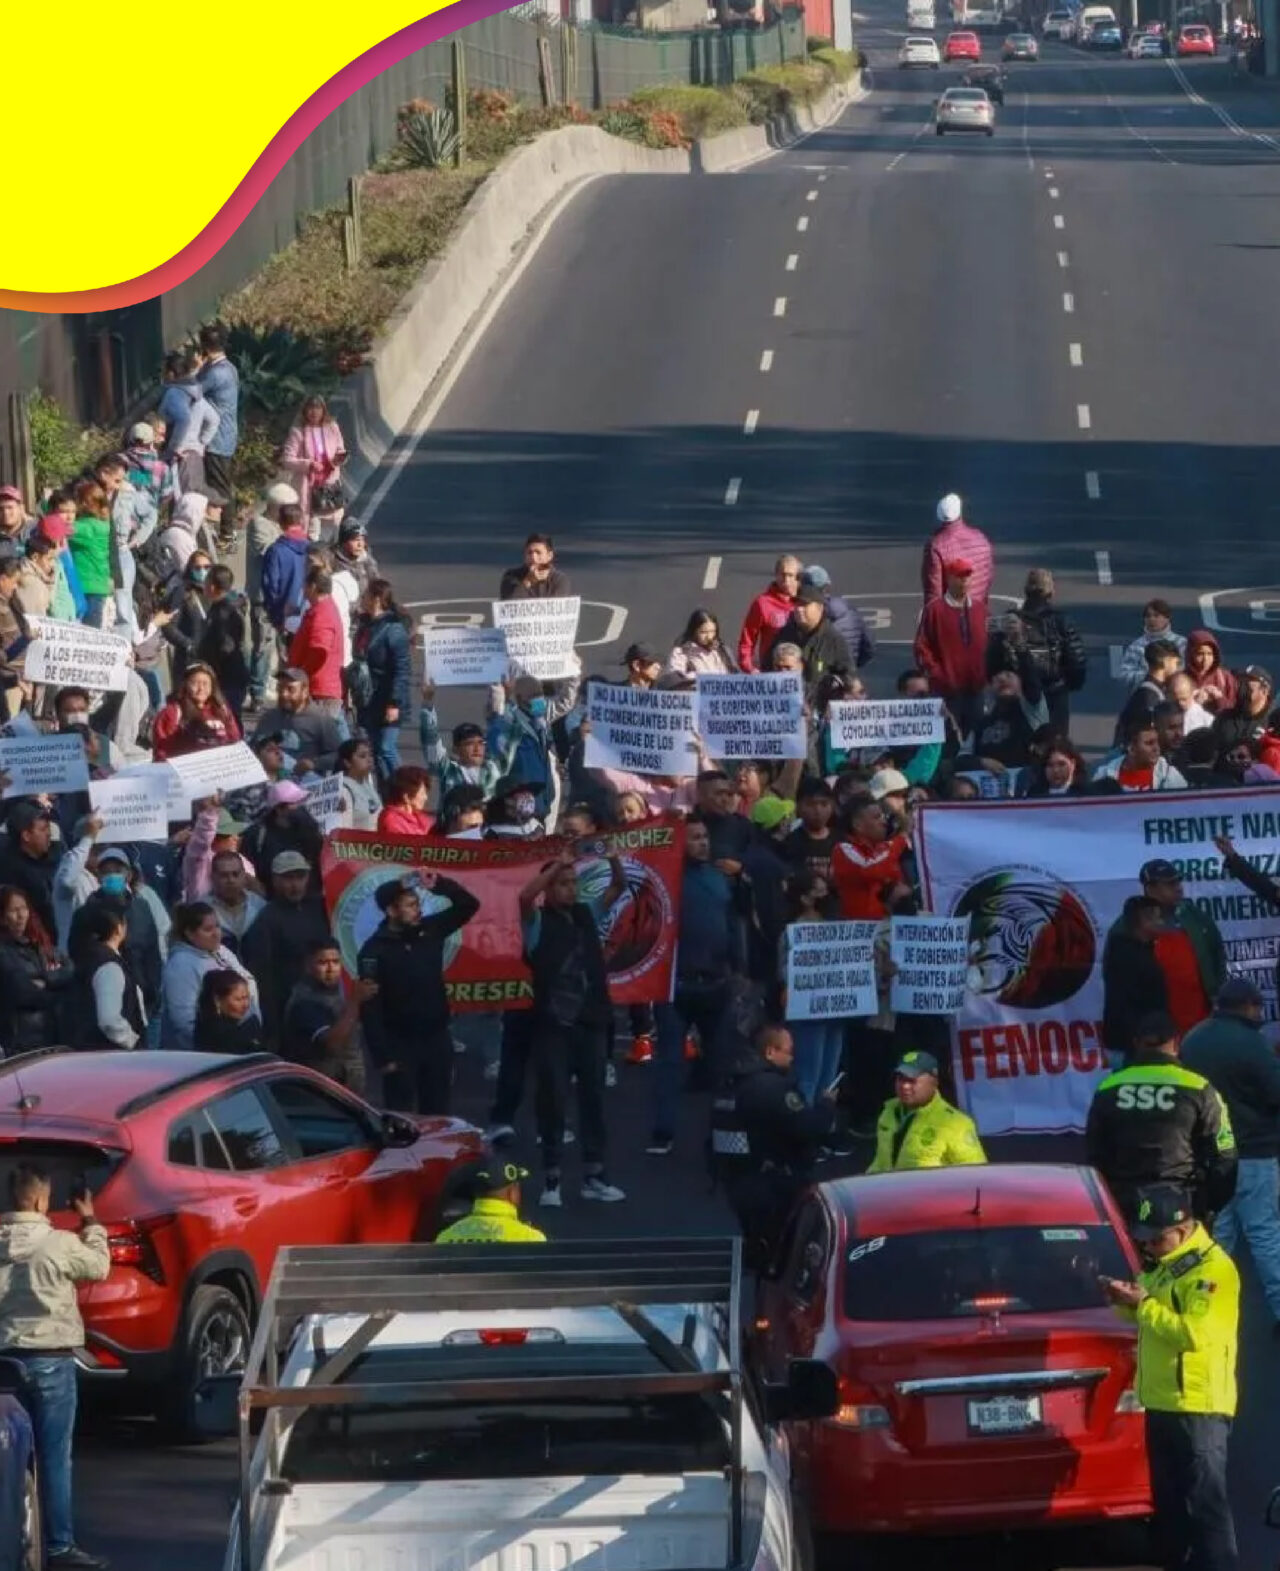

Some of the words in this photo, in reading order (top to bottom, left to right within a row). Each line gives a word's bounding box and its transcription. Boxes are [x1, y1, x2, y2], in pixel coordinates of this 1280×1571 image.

[44, 646, 51, 660] A
[53, 647, 70, 662] LOS
[72, 648, 118, 666] PERMISOS
[45, 665, 58, 680] DE
[700, 676, 754, 696] INTERVENCIÓN
[755, 679, 767, 695] DE
[768, 679, 778, 694] LA
[780, 677, 799, 694] JEFA
[610, 687, 616, 702] A
[618, 688, 628, 705] LA
[632, 690, 659, 709] LIMPIA
[661, 694, 692, 710] SOCIAL
[709, 700, 720, 716] DE
[721, 699, 761, 716] GOBIERNO
[763, 699, 774, 715] EN
[776, 699, 790, 714] LAS
[591, 706, 602, 722] DE
[604, 708, 668, 730] COMERCIANTES
[670, 715, 682, 731] EN
[684, 716, 693, 731] EL
[839, 705, 886, 721] SIGUIENTES
[707, 719, 752, 735] SIGUIENTES
[889, 721, 933, 738] IZTACALCO
[609, 729, 642, 747] PARQUE
[644, 733, 655, 749] DE
[657, 734, 674, 751] LOS
[725, 740, 752, 755] BENITO
[1144, 814, 1235, 845] FRENTE
[331, 839, 416, 862] TIANGUIS
[419, 846, 480, 864] RURAL
[895, 922, 953, 942] INTERVENCIÓN
[904, 947, 913, 963] DE
[916, 947, 958, 964] GOBIERNO
[912, 991, 943, 1010] BENITO
[1116, 1085, 1176, 1111] SSC
